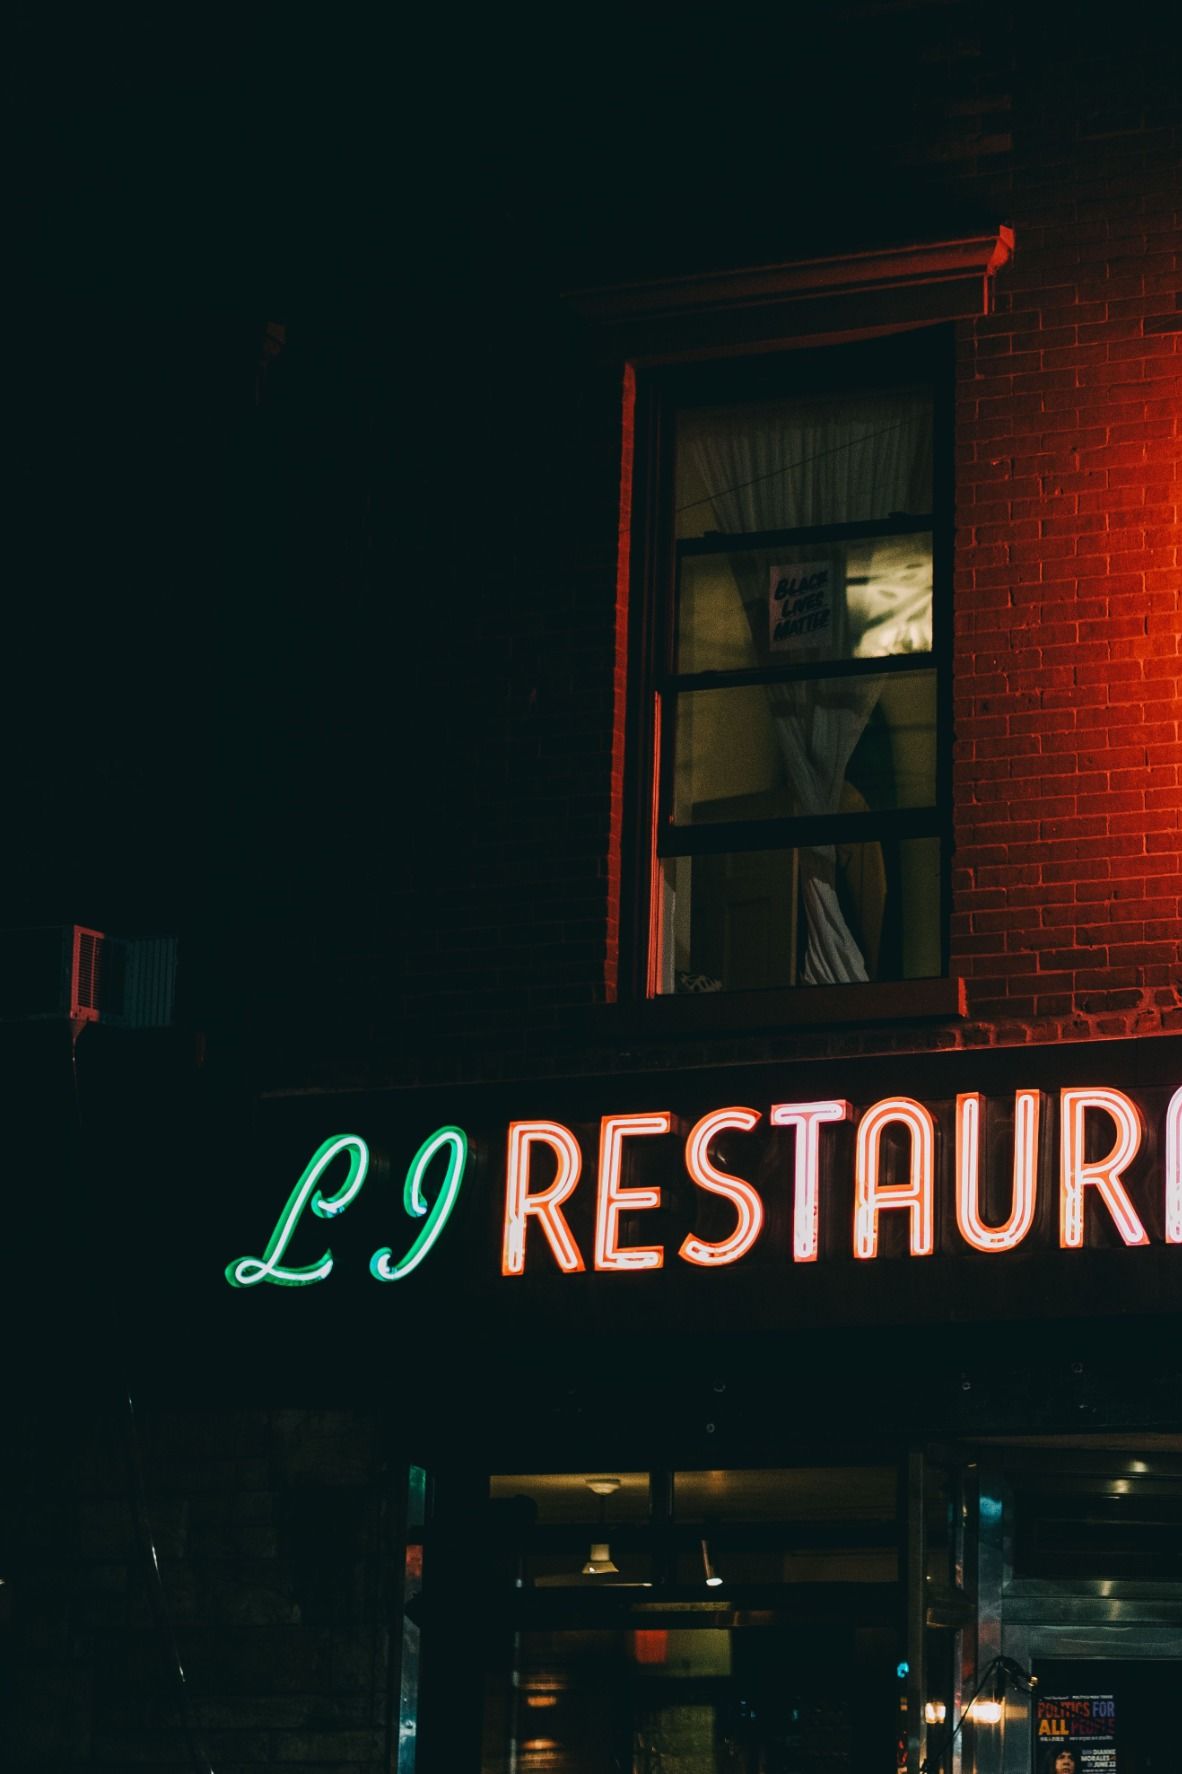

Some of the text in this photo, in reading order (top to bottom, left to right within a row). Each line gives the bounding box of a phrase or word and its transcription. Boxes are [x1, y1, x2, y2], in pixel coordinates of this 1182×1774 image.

[775, 570, 828, 600] BLACK
[774, 608, 830, 640] MATTER
[225, 1133, 369, 1289] L
[1037, 1700, 1116, 1719] POLITICS FOR
[1038, 1718, 1070, 1735] ALL
